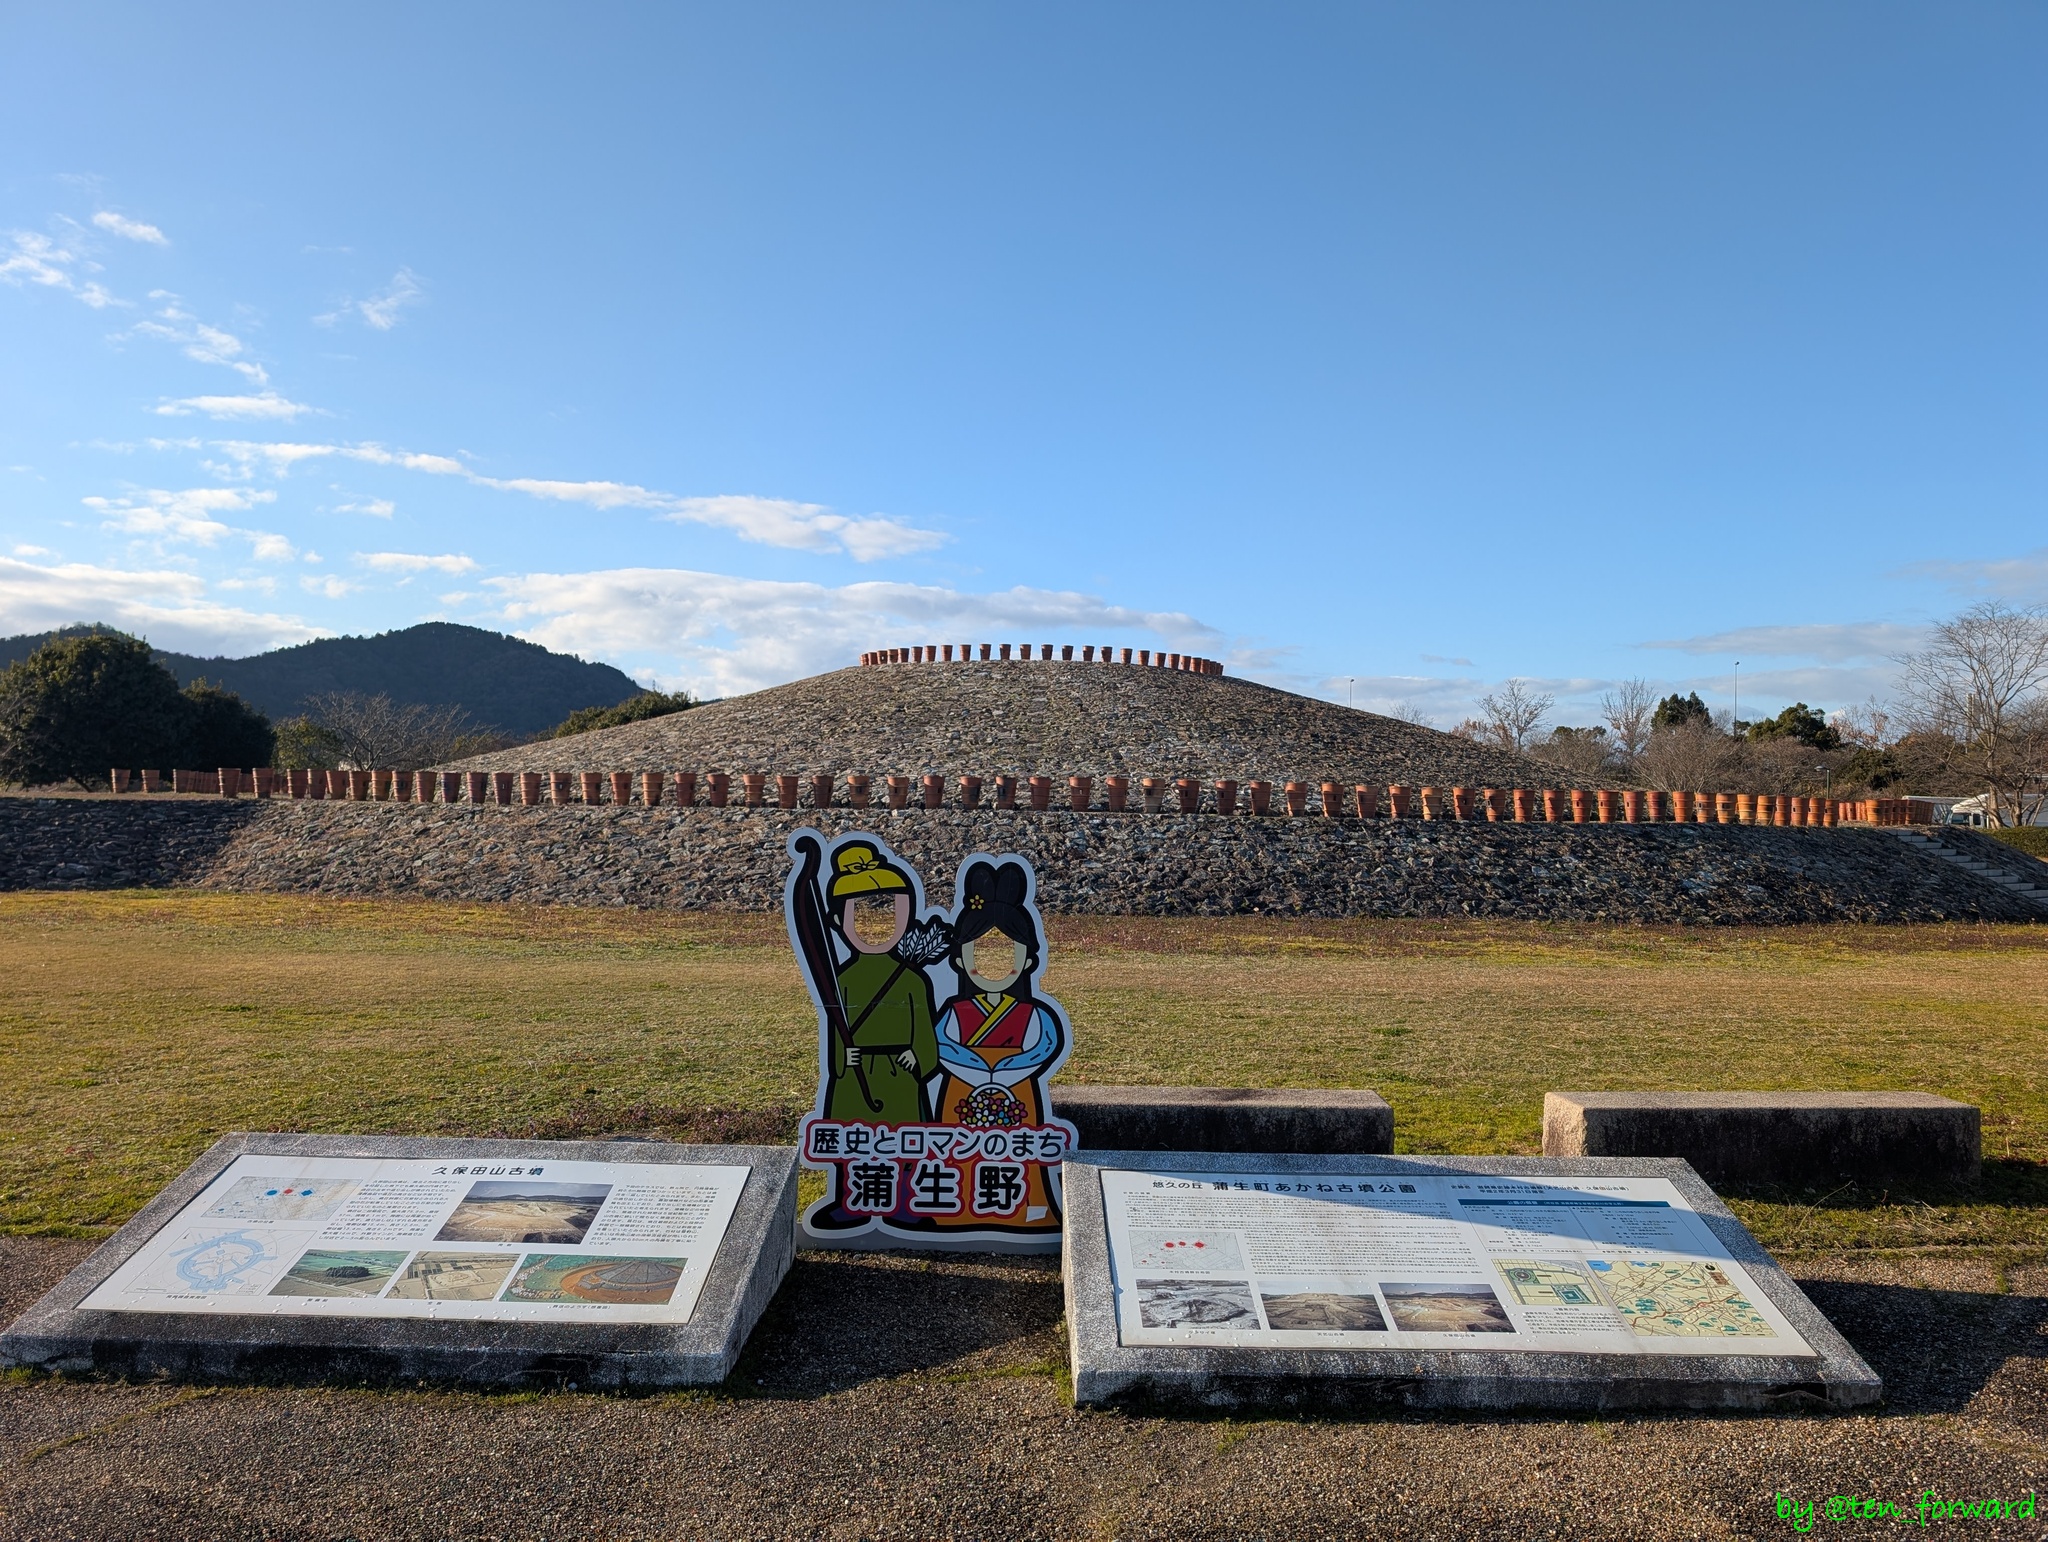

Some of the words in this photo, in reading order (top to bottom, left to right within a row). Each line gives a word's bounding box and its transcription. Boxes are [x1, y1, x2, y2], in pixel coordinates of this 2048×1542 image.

[812, 1127, 1063, 1158] 歴史とロマンのまち
[431, 1166, 545, 1176] 久保田山古墳
[850, 1162, 1023, 1210] 蒲生野
[1152, 1181, 1204, 1190] 悠久の丘
[1212, 1181, 1417, 1194] 蒲生町あかね古墳公園
